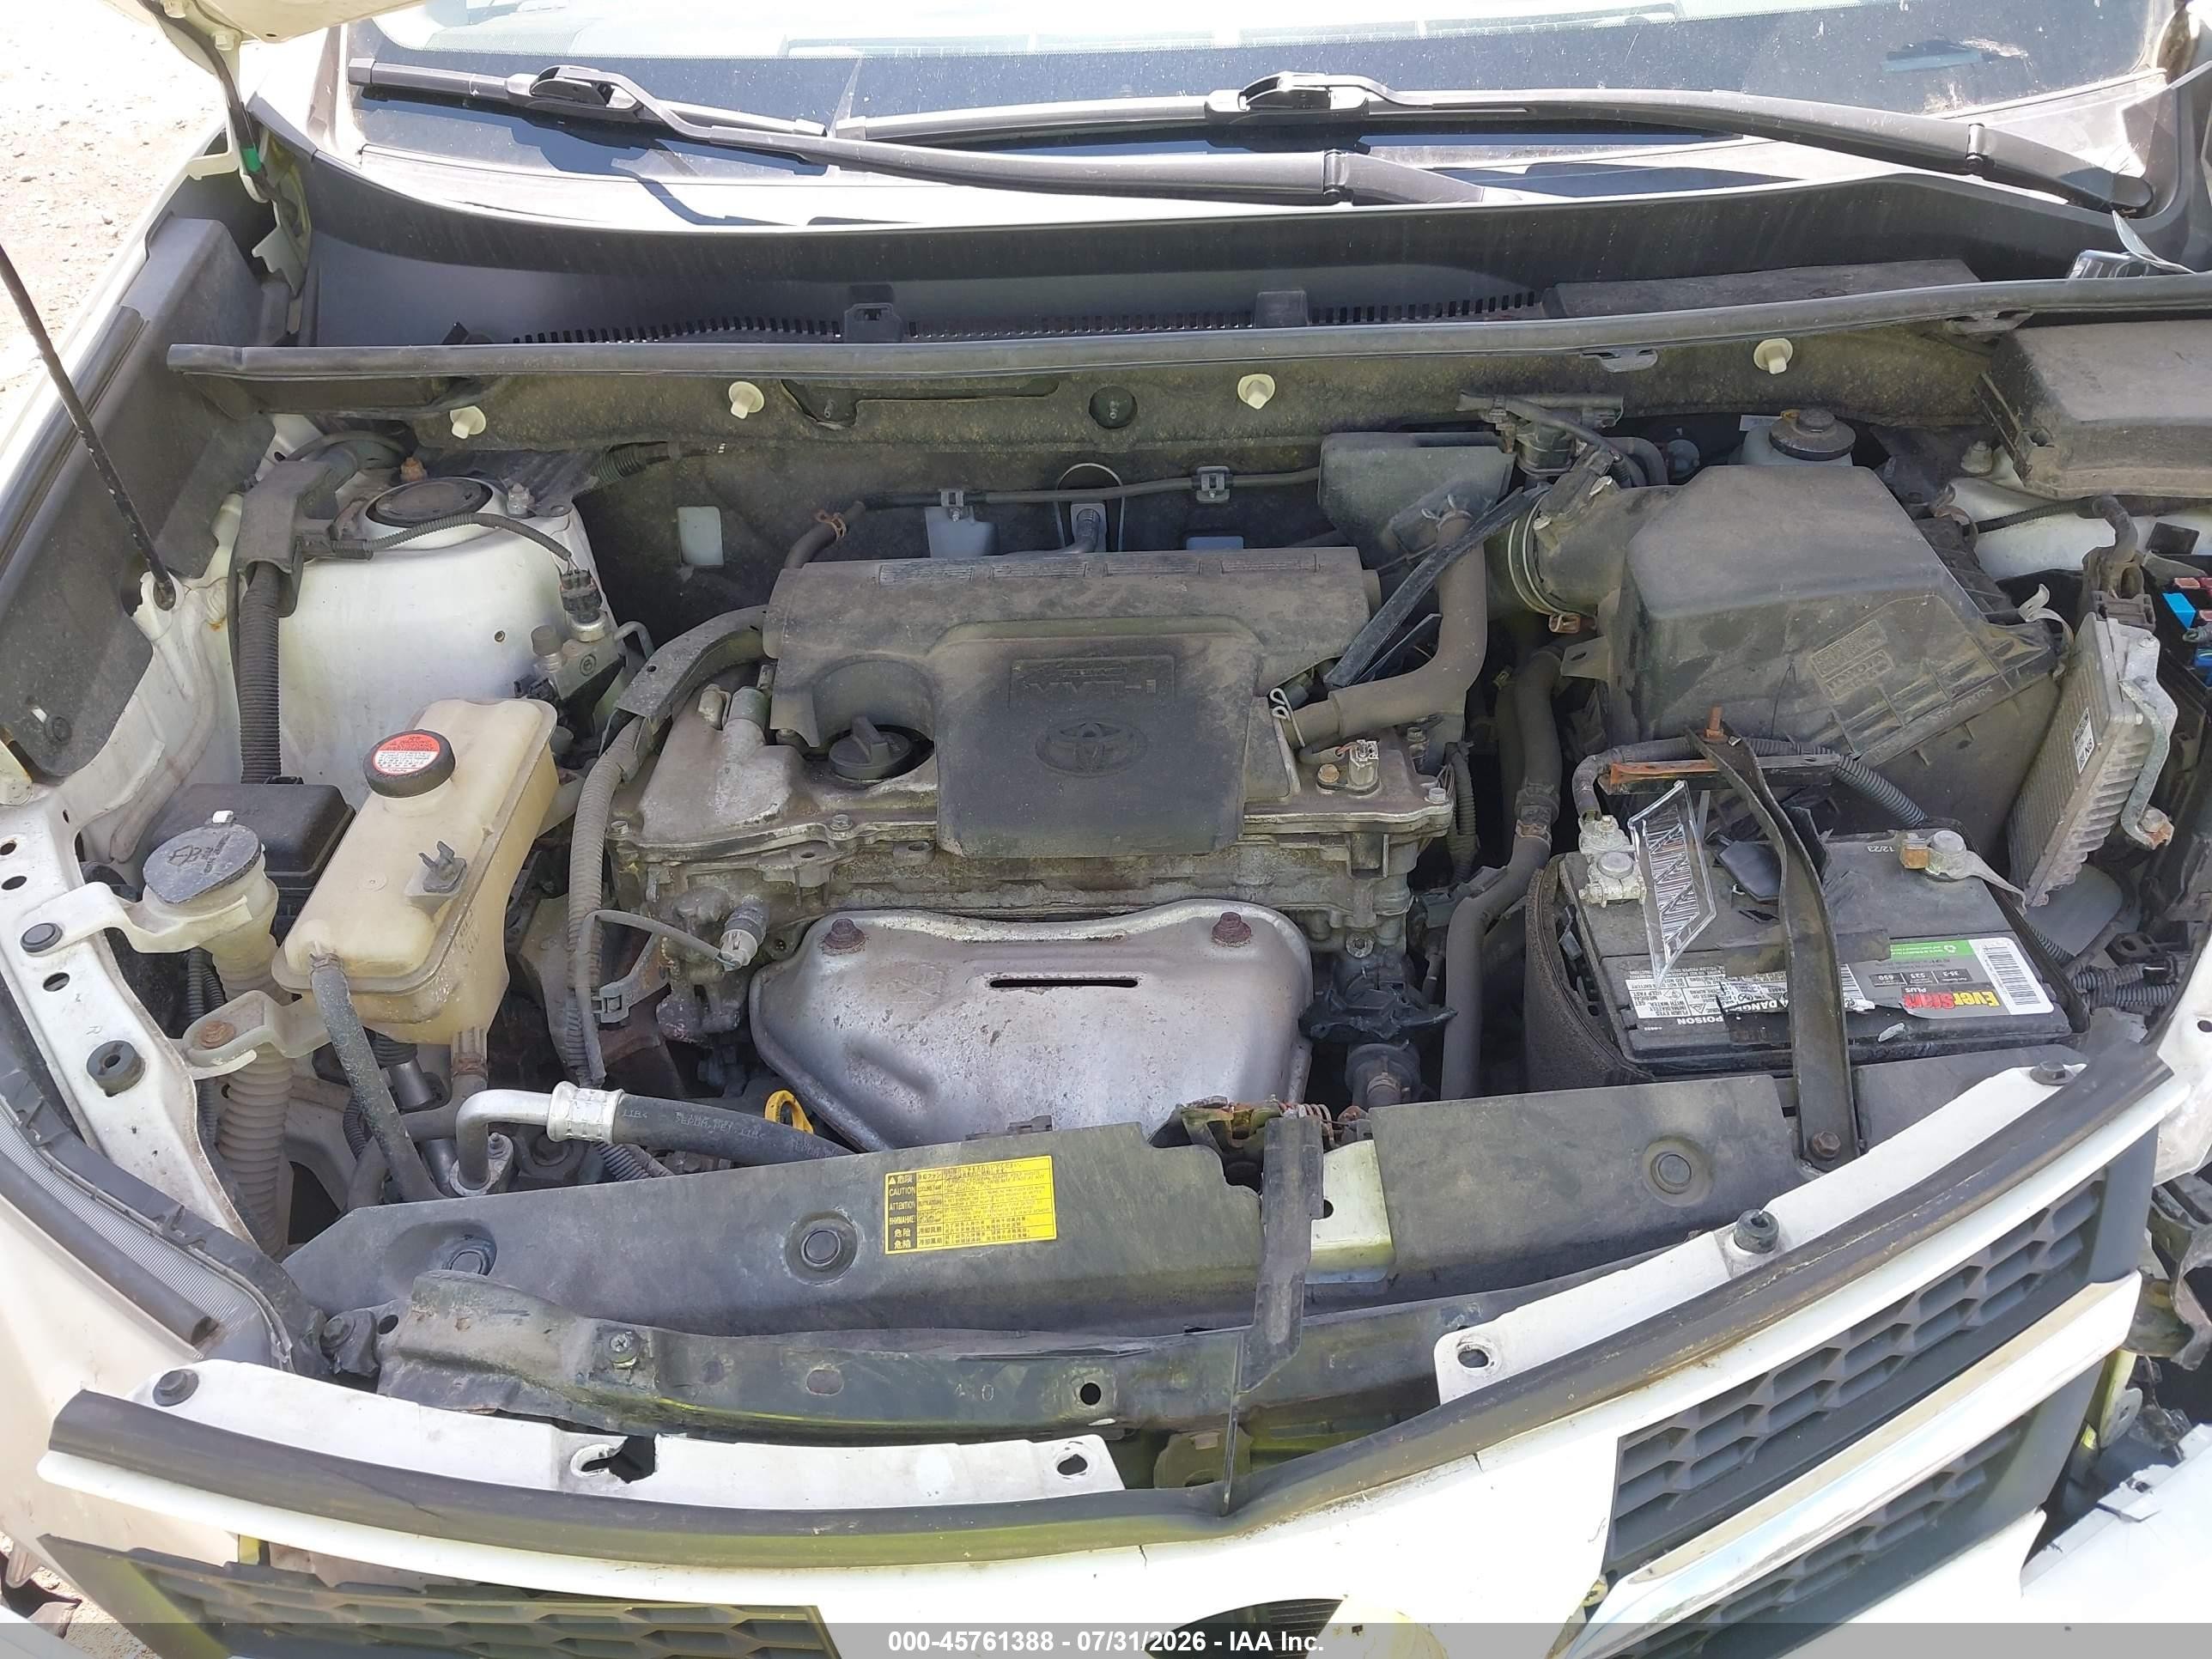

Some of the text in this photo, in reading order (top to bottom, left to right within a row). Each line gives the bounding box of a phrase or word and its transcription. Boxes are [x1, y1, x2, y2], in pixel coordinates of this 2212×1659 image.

[1902, 991, 2001, 1009] EverStart
[1676, 1016, 1723, 1024] POISON
[889, 1186, 916, 1196] CAUTION
[889, 1200, 916, 1211] ATTENTION
